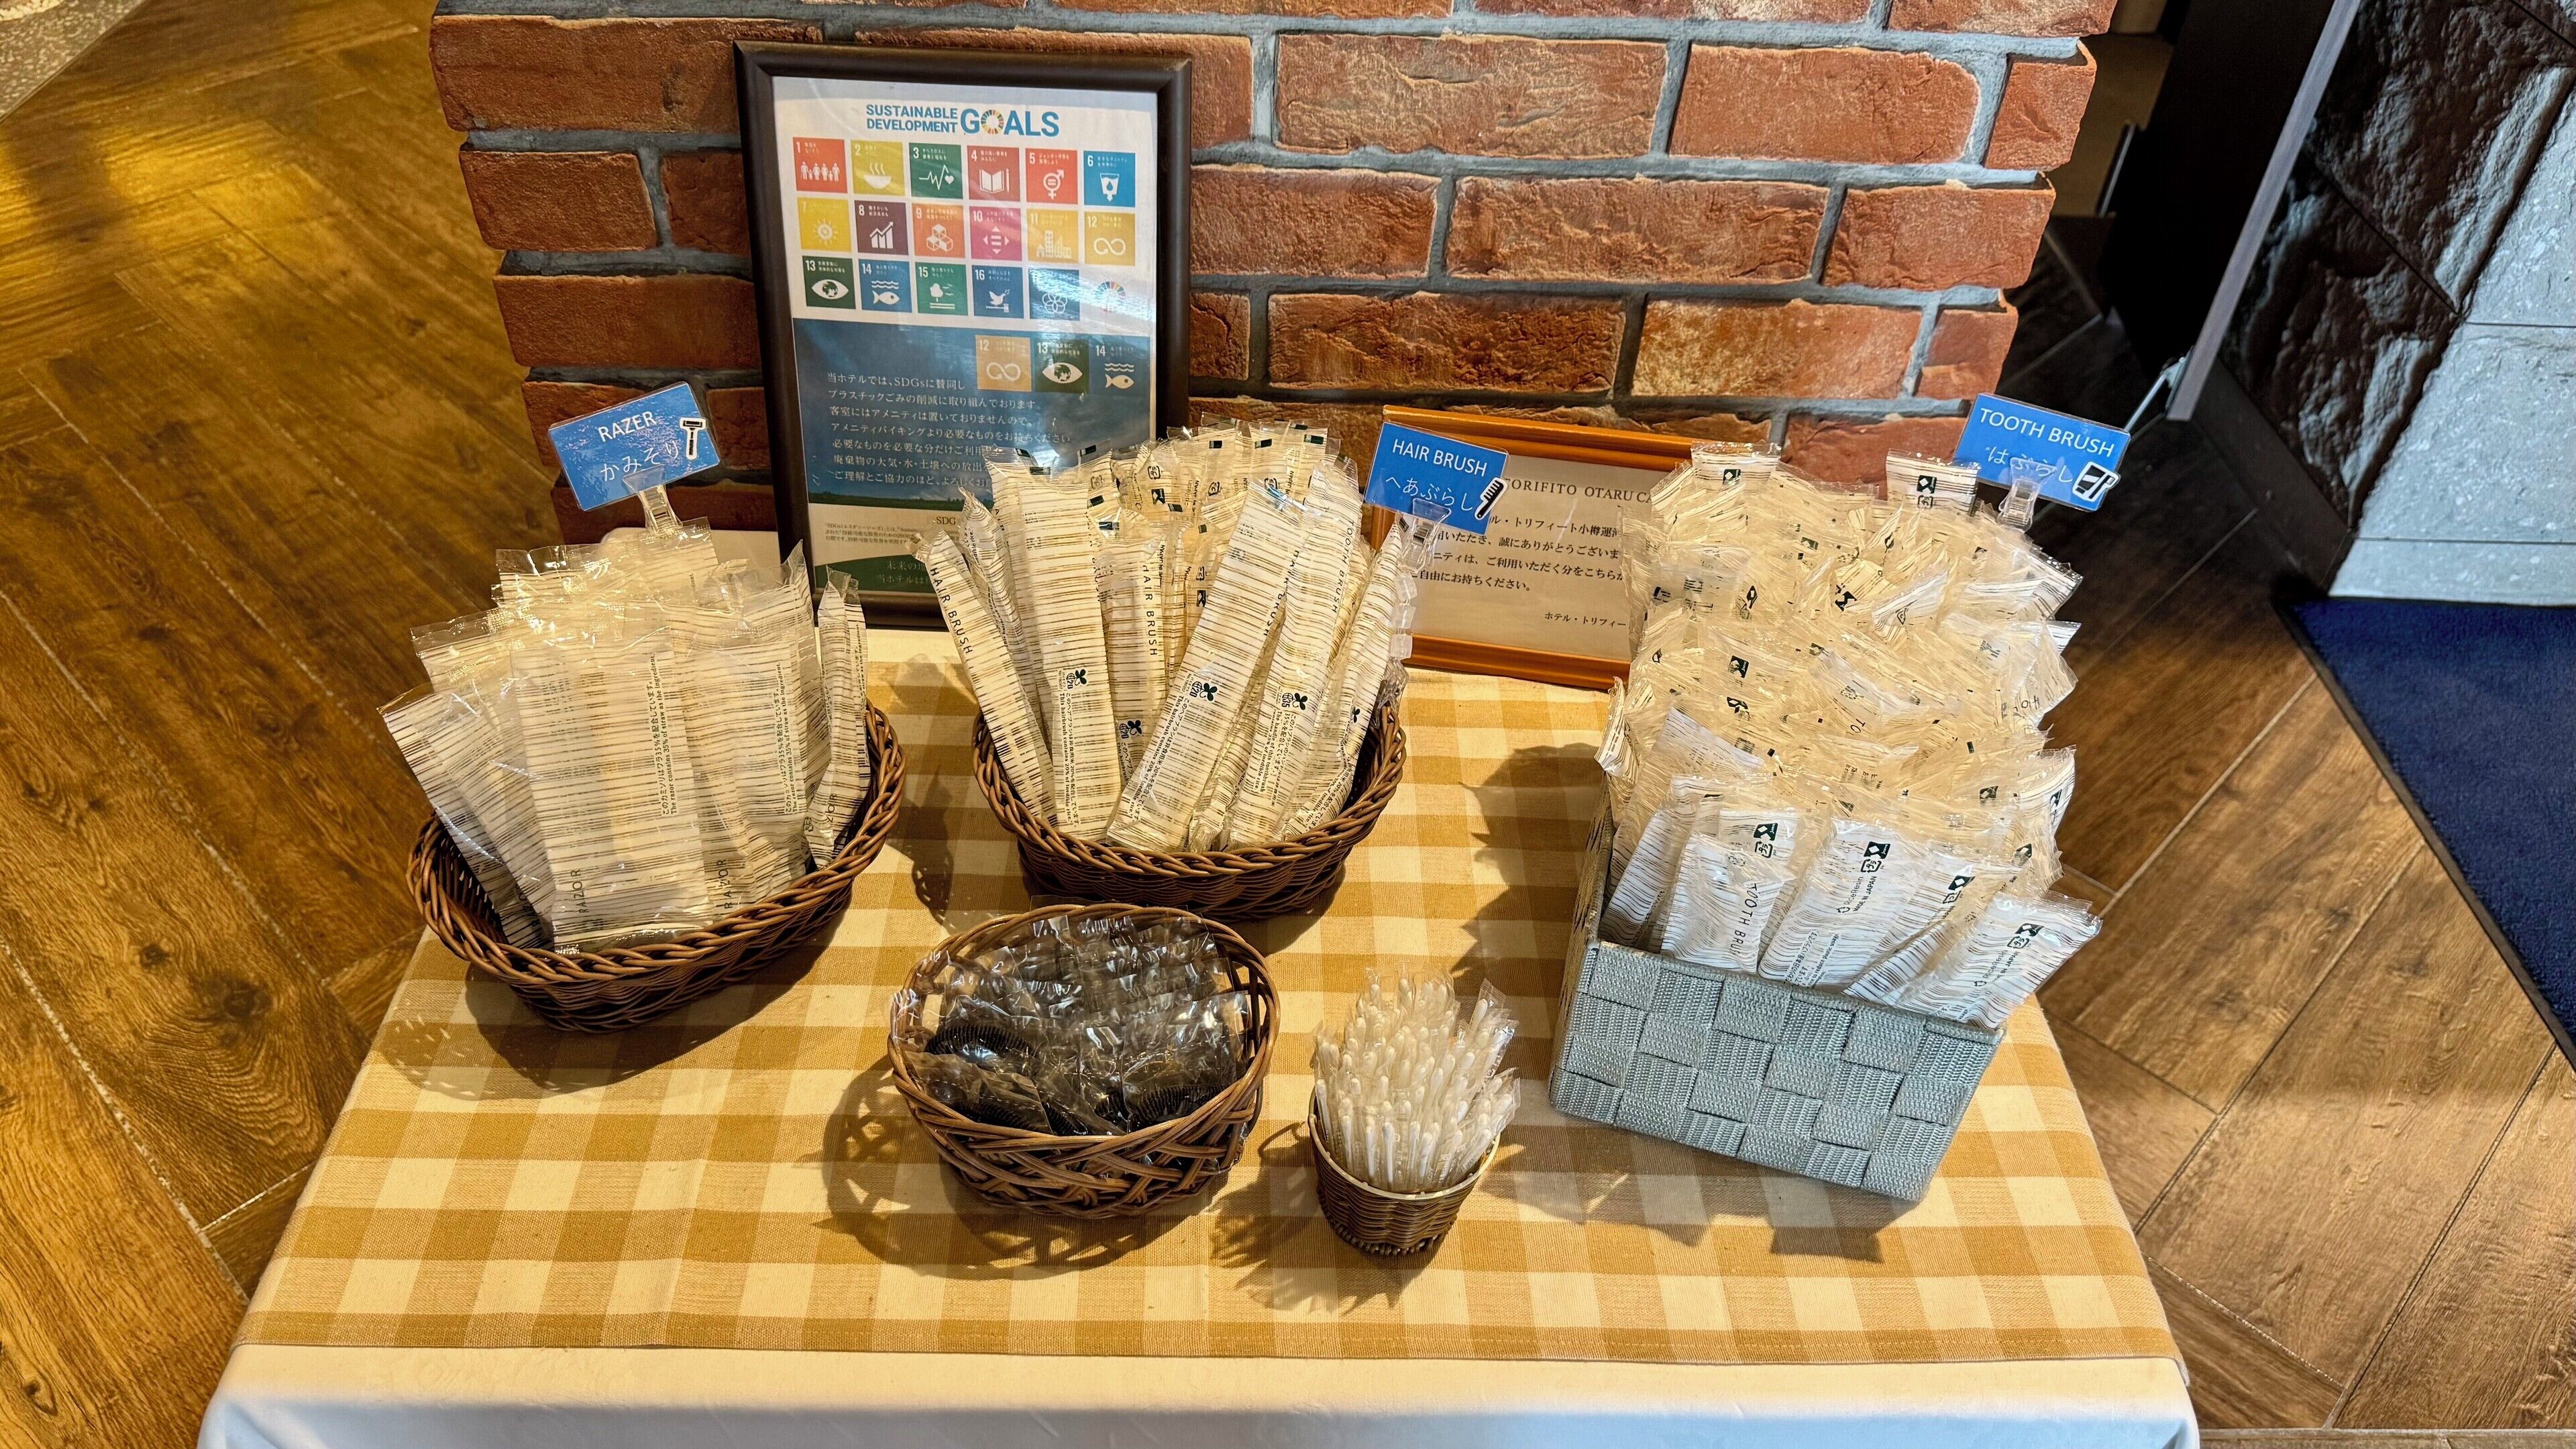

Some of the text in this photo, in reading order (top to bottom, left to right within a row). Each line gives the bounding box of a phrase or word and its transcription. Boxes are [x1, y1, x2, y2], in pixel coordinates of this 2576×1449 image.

[866, 104, 1060, 137] SUSTAINABLE GOALS
[867, 118, 958, 133] DEVELOPMENT
[796, 142, 801, 153] 1
[854, 144, 861, 156] 2
[913, 147, 920, 159] 3
[971, 150, 977, 162] 4
[1029, 152, 1036, 164] 5
[1087, 155, 1093, 166] 6
[859, 205, 865, 216] 8
[916, 208, 922, 219] 9
[973, 211, 983, 222] 10
[1087, 216, 1097, 227] 12
[805, 260, 816, 271] 13
[862, 264, 872, 274] 14
[918, 266, 928, 277] 15
[975, 270, 985, 280] 16
[979, 340, 989, 352] 12
[1037, 342, 1048, 354] 13
[1095, 345, 1106, 356] 14
[597, 411, 657, 442] RAZER
[1980, 408, 2114, 458] TOOTH BRUSH
[600, 440, 679, 482] かみそり
[1393, 439, 1488, 477] HAIR BRUSH
[1987, 445, 2073, 483] はぶらし
[1385, 476, 1474, 512] へあぶらし
[1585, 486, 1634, 501] OTARU
[1332, 520, 1355, 614] TOOTH BRUSH
[1411, 570, 1529, 591] 自由にお持ちください。
[930, 567, 973, 654] HAIR BRUSH
[1142, 565, 1158, 655] HAIR BRUSH
[649, 655, 661, 688] ingredient.
[775, 662, 786, 695] ingredient.
[1175, 695, 1183, 707] This
[1188, 687, 1199, 698] 20
[1281, 698, 1291, 708] 35
[1163, 708, 1177, 735] hairbrush
[1120, 730, 1128, 739] 20
[1152, 736, 1165, 759] contains
[663, 754, 673, 781] contains
[786, 757, 795, 782] contains
[1146, 760, 1155, 773] 20%
[1258, 753, 1267, 776] inedible
[1260, 761, 1270, 792] toothbrush
[1132, 780, 1146, 800] inedible
[669, 801, 678, 814] The
[570, 868, 589, 914] RAZOR
[716, 859, 734, 909] RAZOR
[1844, 876, 1864, 905] RiceResin
[1866, 876, 1877, 896] JAPAN
[1741, 882, 1758, 926] TOOTH
